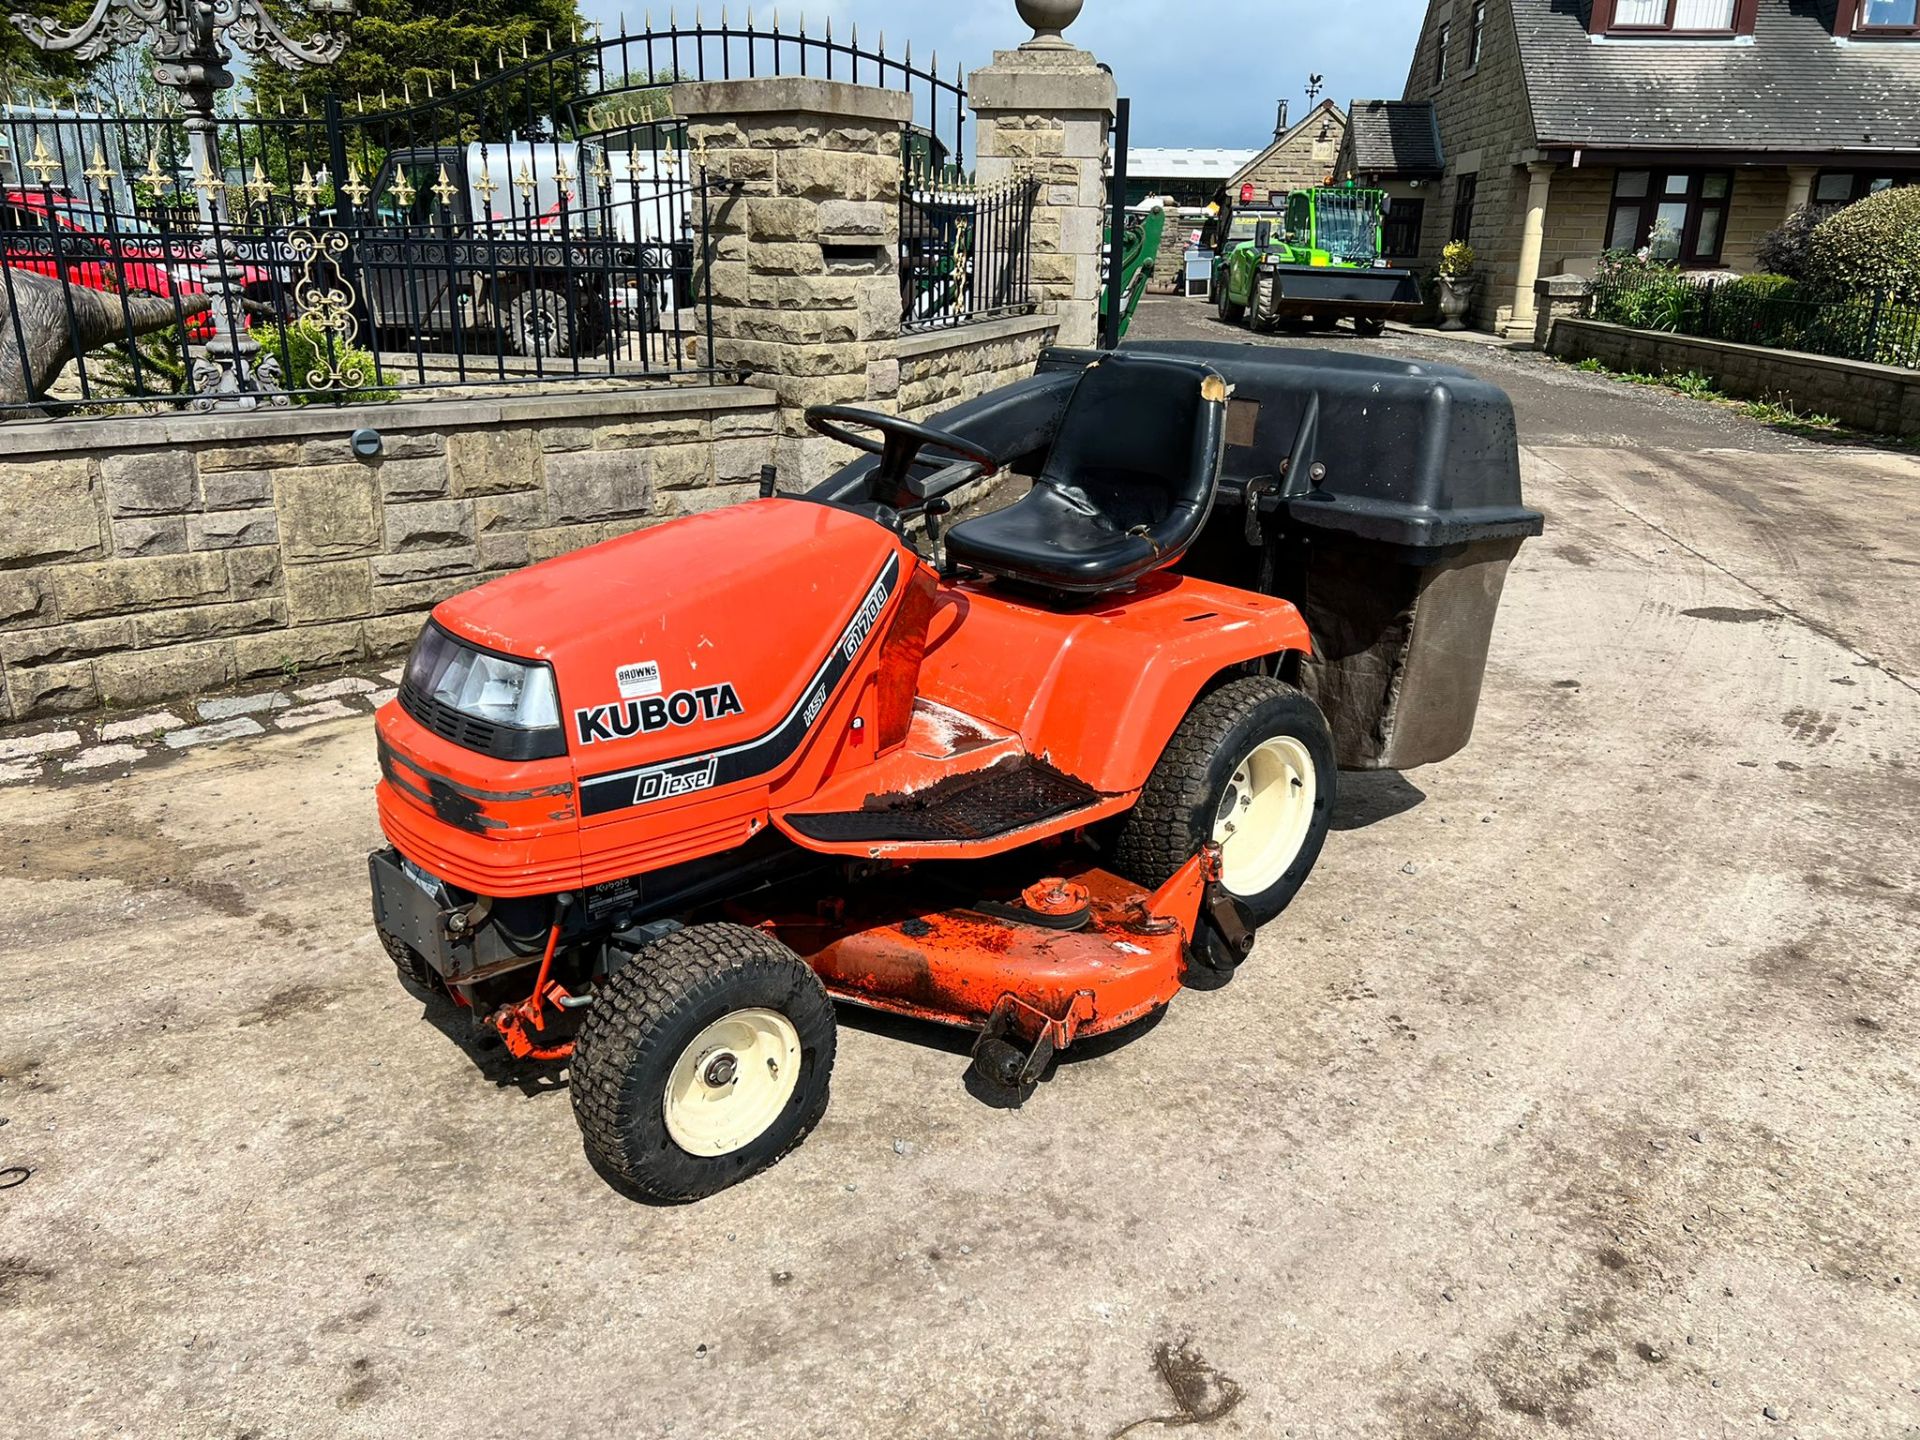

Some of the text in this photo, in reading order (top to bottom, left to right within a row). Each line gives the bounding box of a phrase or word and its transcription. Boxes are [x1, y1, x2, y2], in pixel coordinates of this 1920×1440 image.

[587, 104, 654, 132] CRICH
[842, 582, 889, 661] G1700
[618, 665, 657, 681] BROWNS
[577, 682, 743, 745] KUBOTA
[802, 683, 827, 728] HST
[632, 757, 719, 805] Diesel
